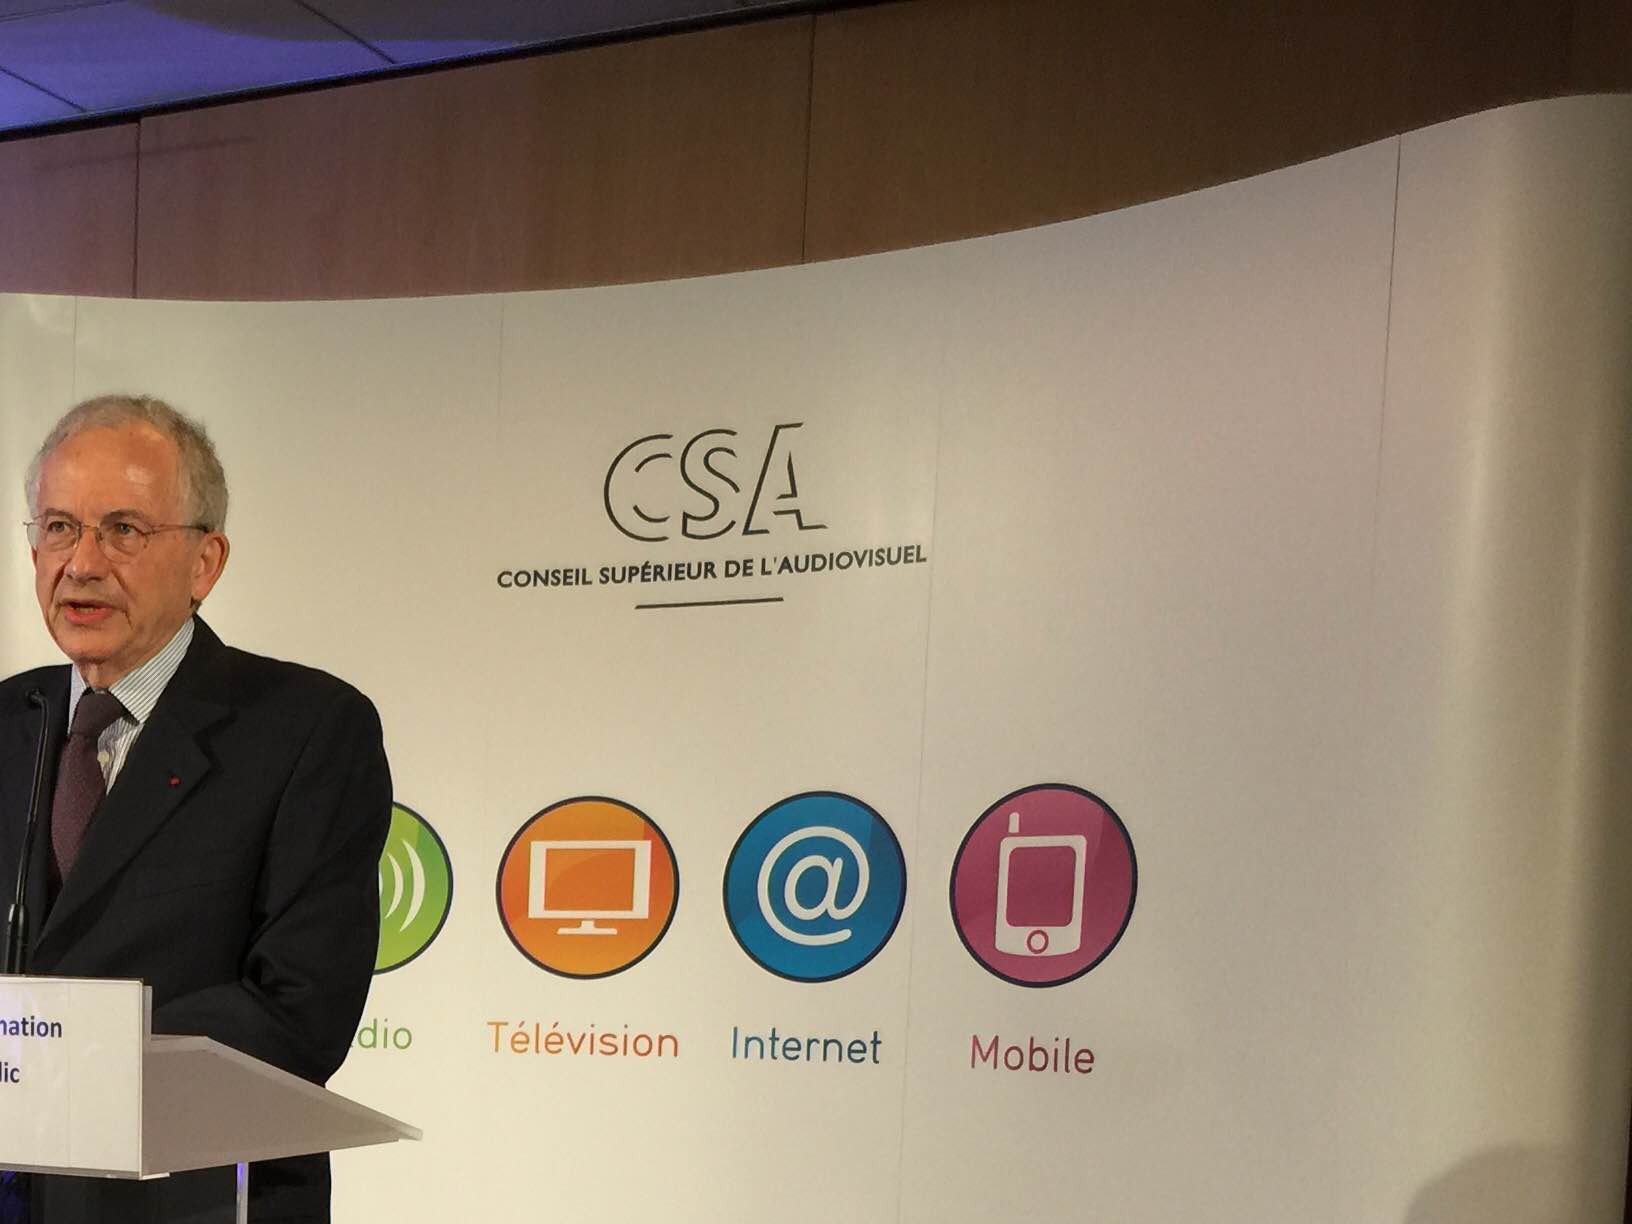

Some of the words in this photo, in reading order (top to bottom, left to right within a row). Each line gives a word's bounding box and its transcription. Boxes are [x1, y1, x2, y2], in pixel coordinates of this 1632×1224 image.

[604, 422, 829, 543] CSA
[496, 567, 593, 589] CONSEIL
[598, 559, 718, 585] SUPÉRIEUR
[724, 559, 754, 578] DE
[760, 544, 928, 577] L'AUDIOVISUEL
[350, 1018, 413, 1050] dio
[487, 1020, 680, 1058] Télévision
[732, 1026, 882, 1065] Internet
[971, 1034, 1095, 1074] Mobile
